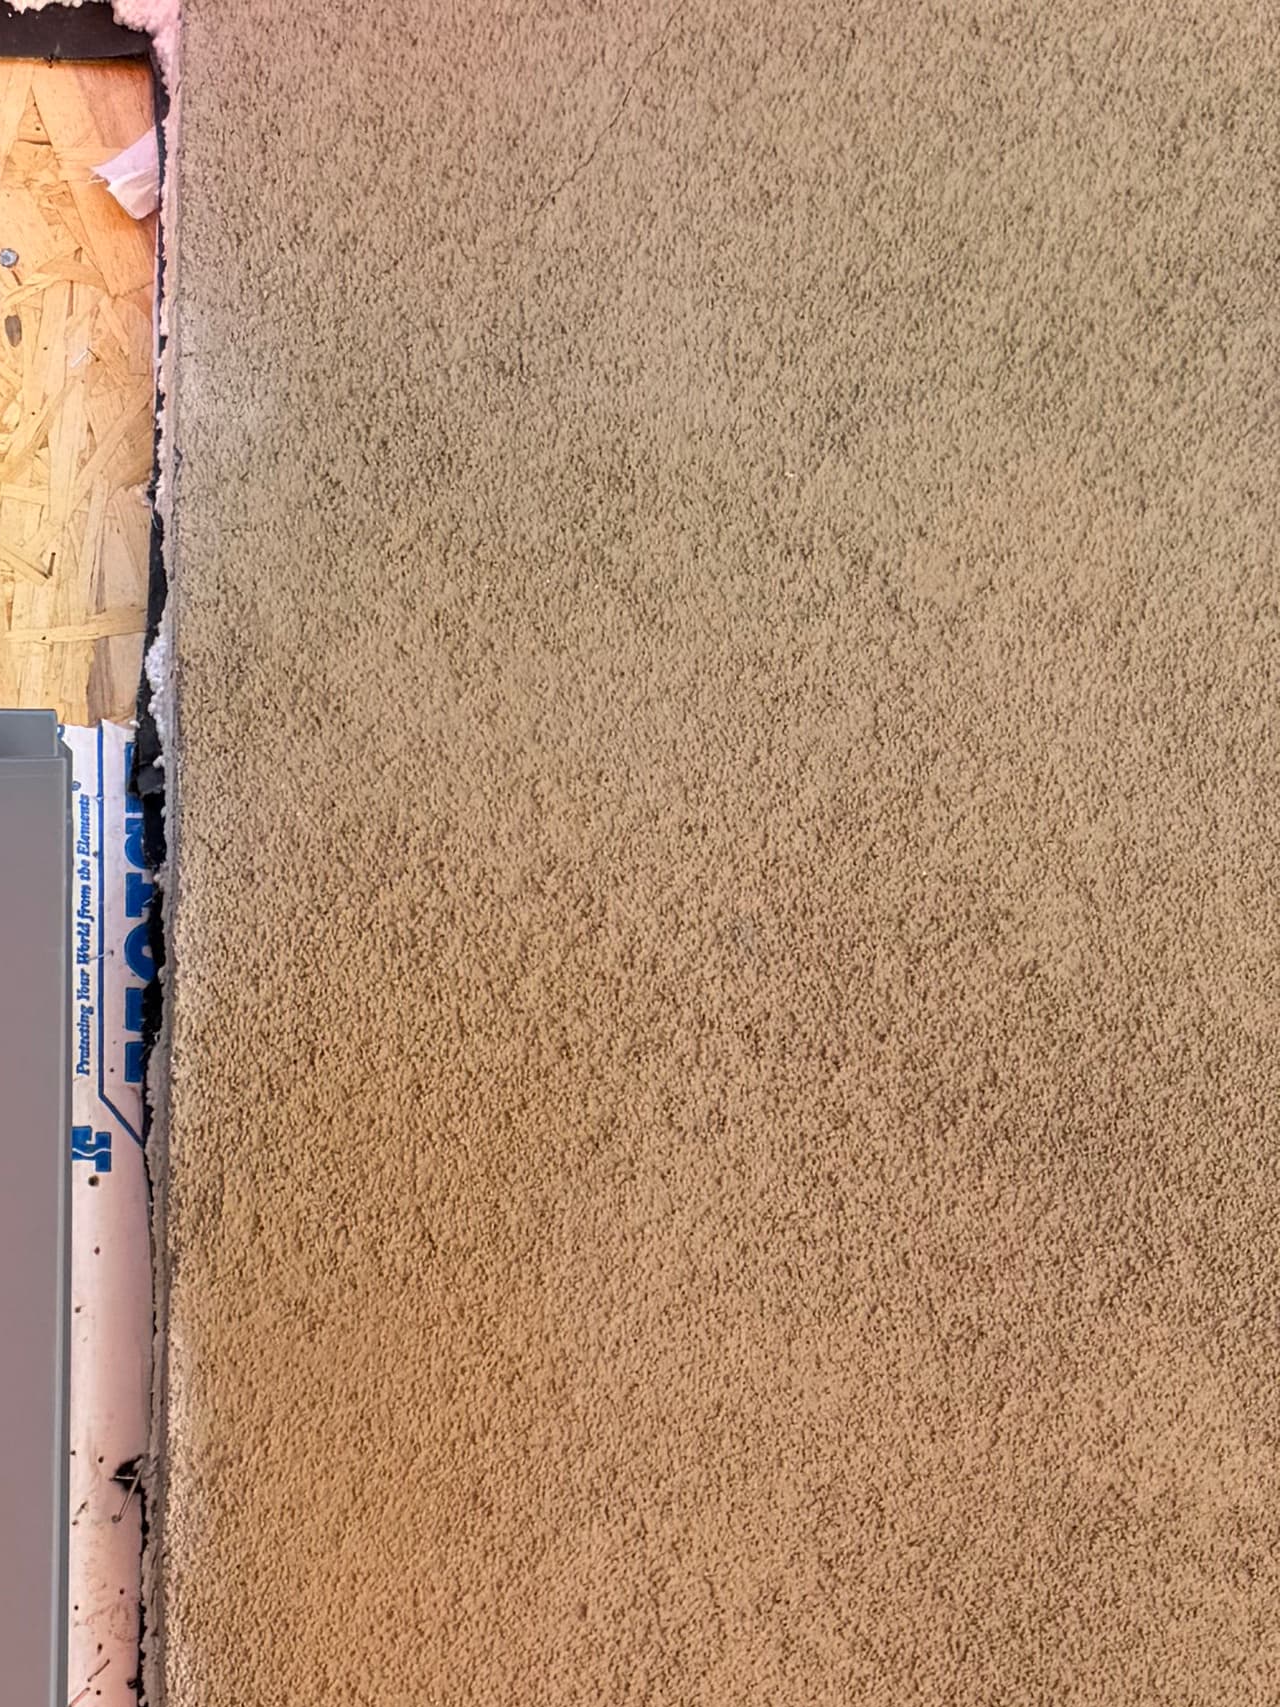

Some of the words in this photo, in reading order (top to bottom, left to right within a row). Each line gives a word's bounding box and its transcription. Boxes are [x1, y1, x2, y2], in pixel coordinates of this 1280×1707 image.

[77, 793, 91, 857] Elements
[77, 859, 91, 881] the
[77, 885, 94, 921] from
[76, 923, 91, 965] World
[76, 968, 91, 1001] Your
[76, 1004, 93, 1076] Protecting
